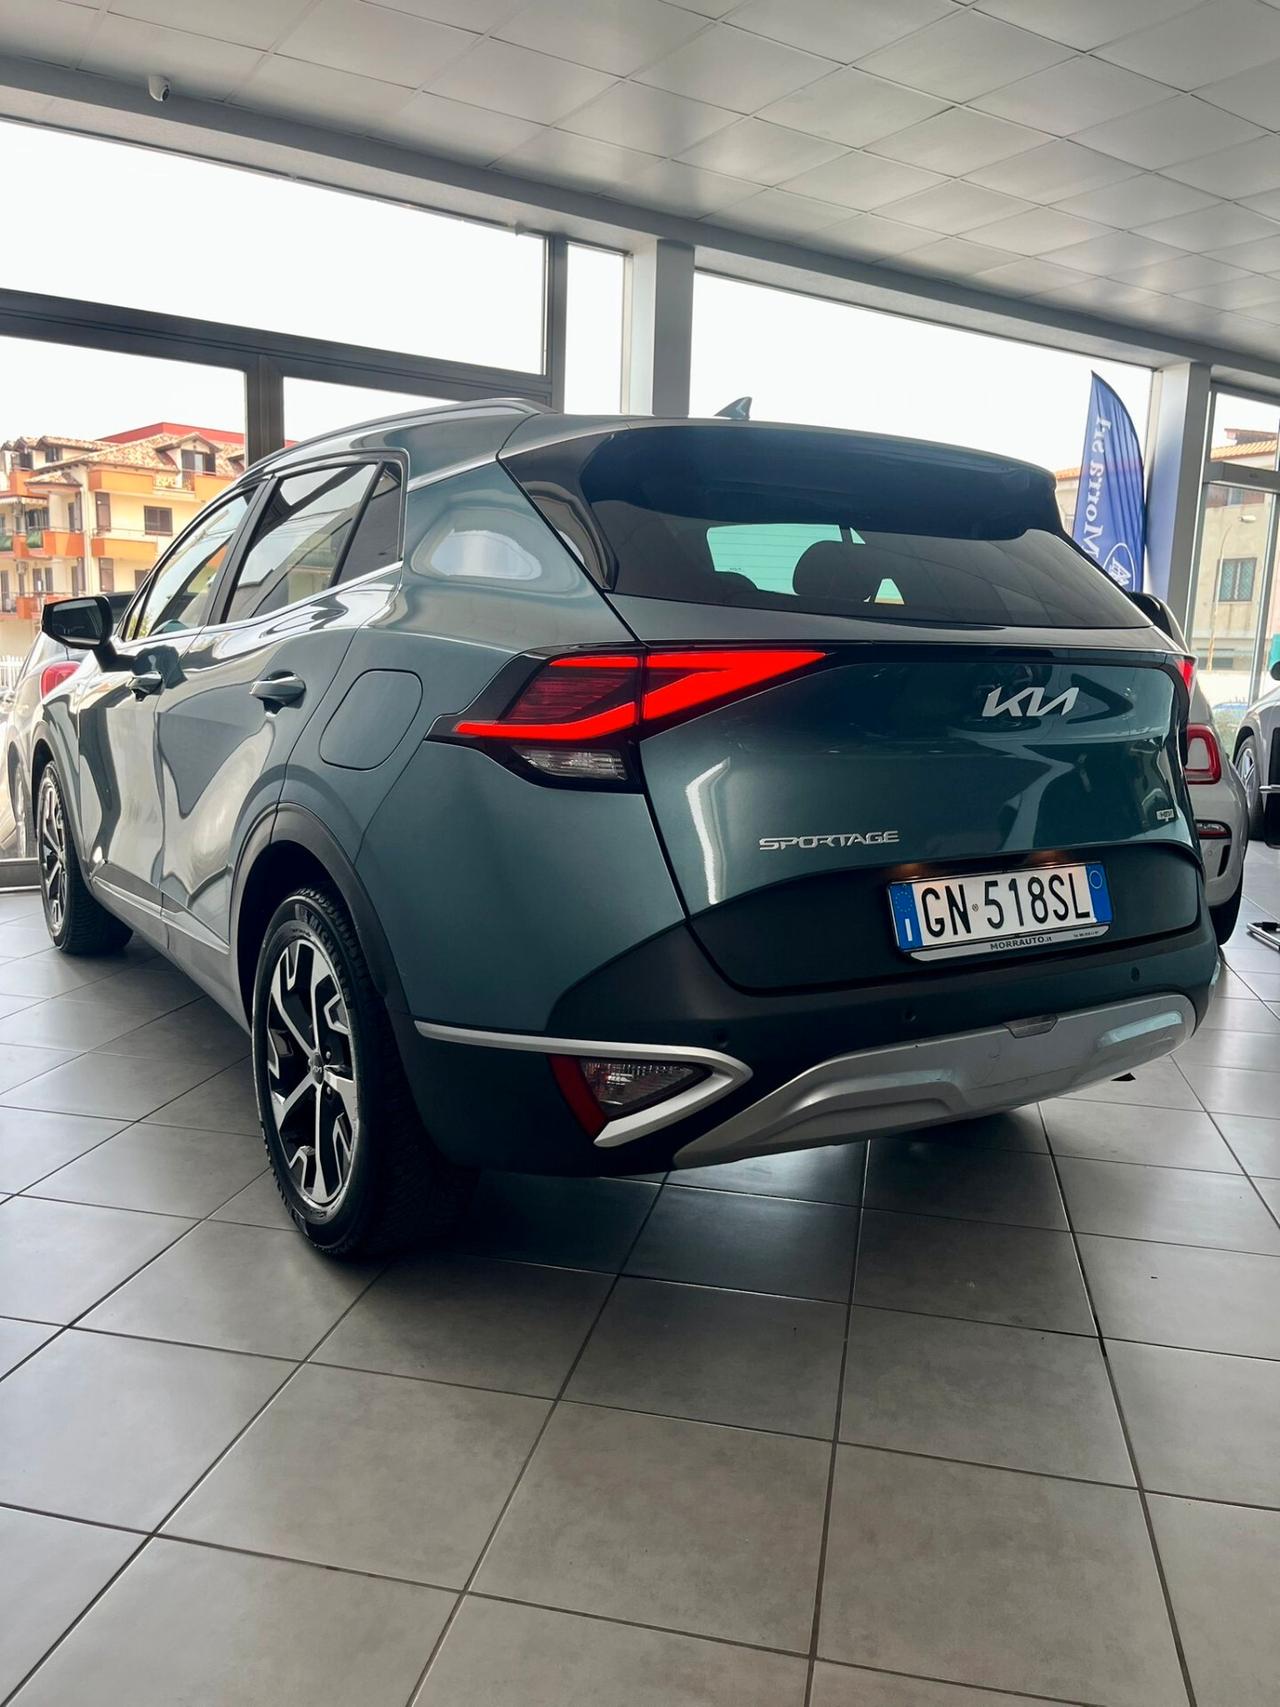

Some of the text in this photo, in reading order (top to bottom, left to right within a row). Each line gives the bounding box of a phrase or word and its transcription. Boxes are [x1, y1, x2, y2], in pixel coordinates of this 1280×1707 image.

[981, 686, 1080, 717] KIA
[758, 830, 901, 851] SPORTAGE
[920, 872, 1090, 938] GN 518SL
[989, 936, 1053, 951] MORRAUTO.it
[308, 914, 353, 1009] MICHELIN
